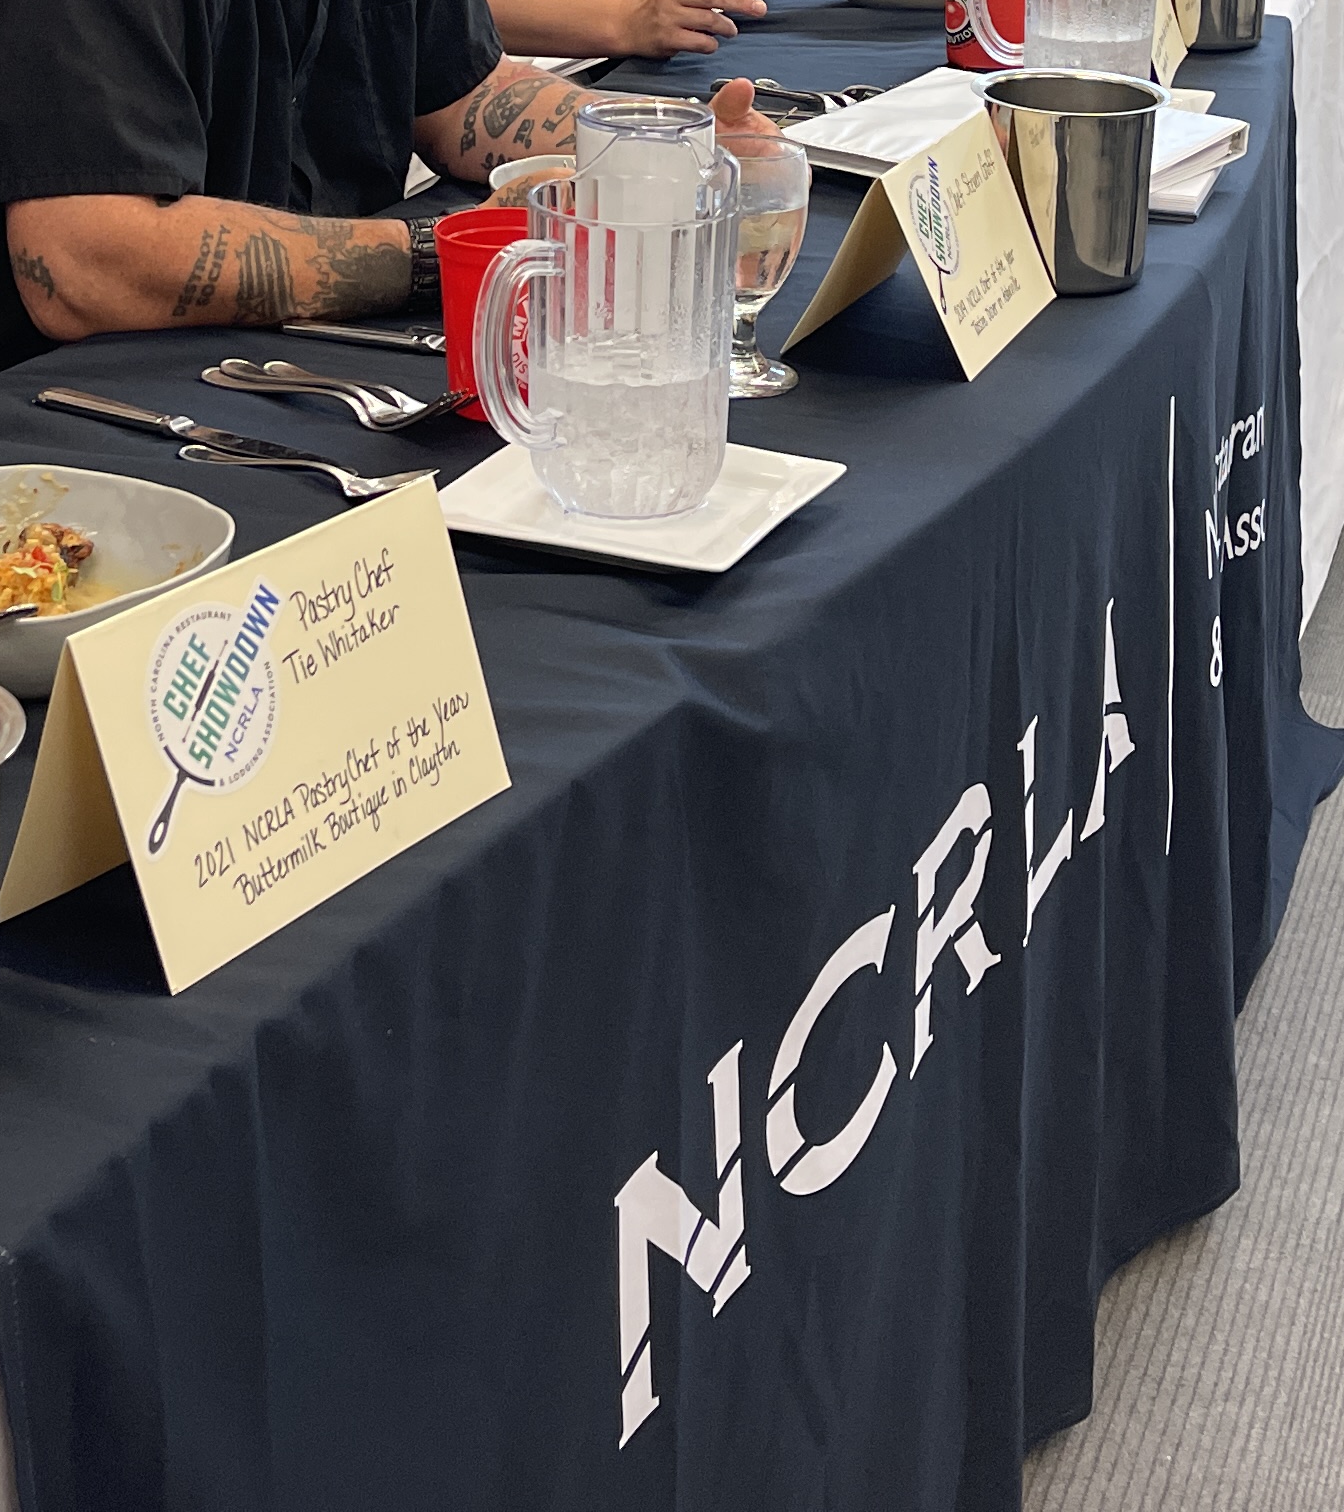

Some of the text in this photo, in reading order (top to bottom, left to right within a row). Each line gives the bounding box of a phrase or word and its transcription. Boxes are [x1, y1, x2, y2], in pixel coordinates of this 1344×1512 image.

[916, 188, 930, 239] CHEF
[927, 155, 947, 266] SHOWDOWN
[288, 547, 395, 632] Pastry Chef
[150, 610, 233, 742] NORTH CAROLINA RESTAURANT
[163, 632, 211, 721] CHEF
[188, 583, 281, 770] SHOWDOWN
[262, 660, 276, 745] ASSOCIATION
[281, 648, 319, 684] Tie
[224, 685, 264, 763] NCRLA
[194, 836, 236, 889] 2021
[242, 797, 296, 852] NCRLA
[346, 737, 381, 782] Chef
[386, 725, 402, 760] of
[406, 716, 431, 749] the
[323, 785, 390, 833] Boutique
[393, 770, 408, 798] in
[409, 739, 461, 787] Clayton
[614, 596, 1136, 1449] NCRLA
